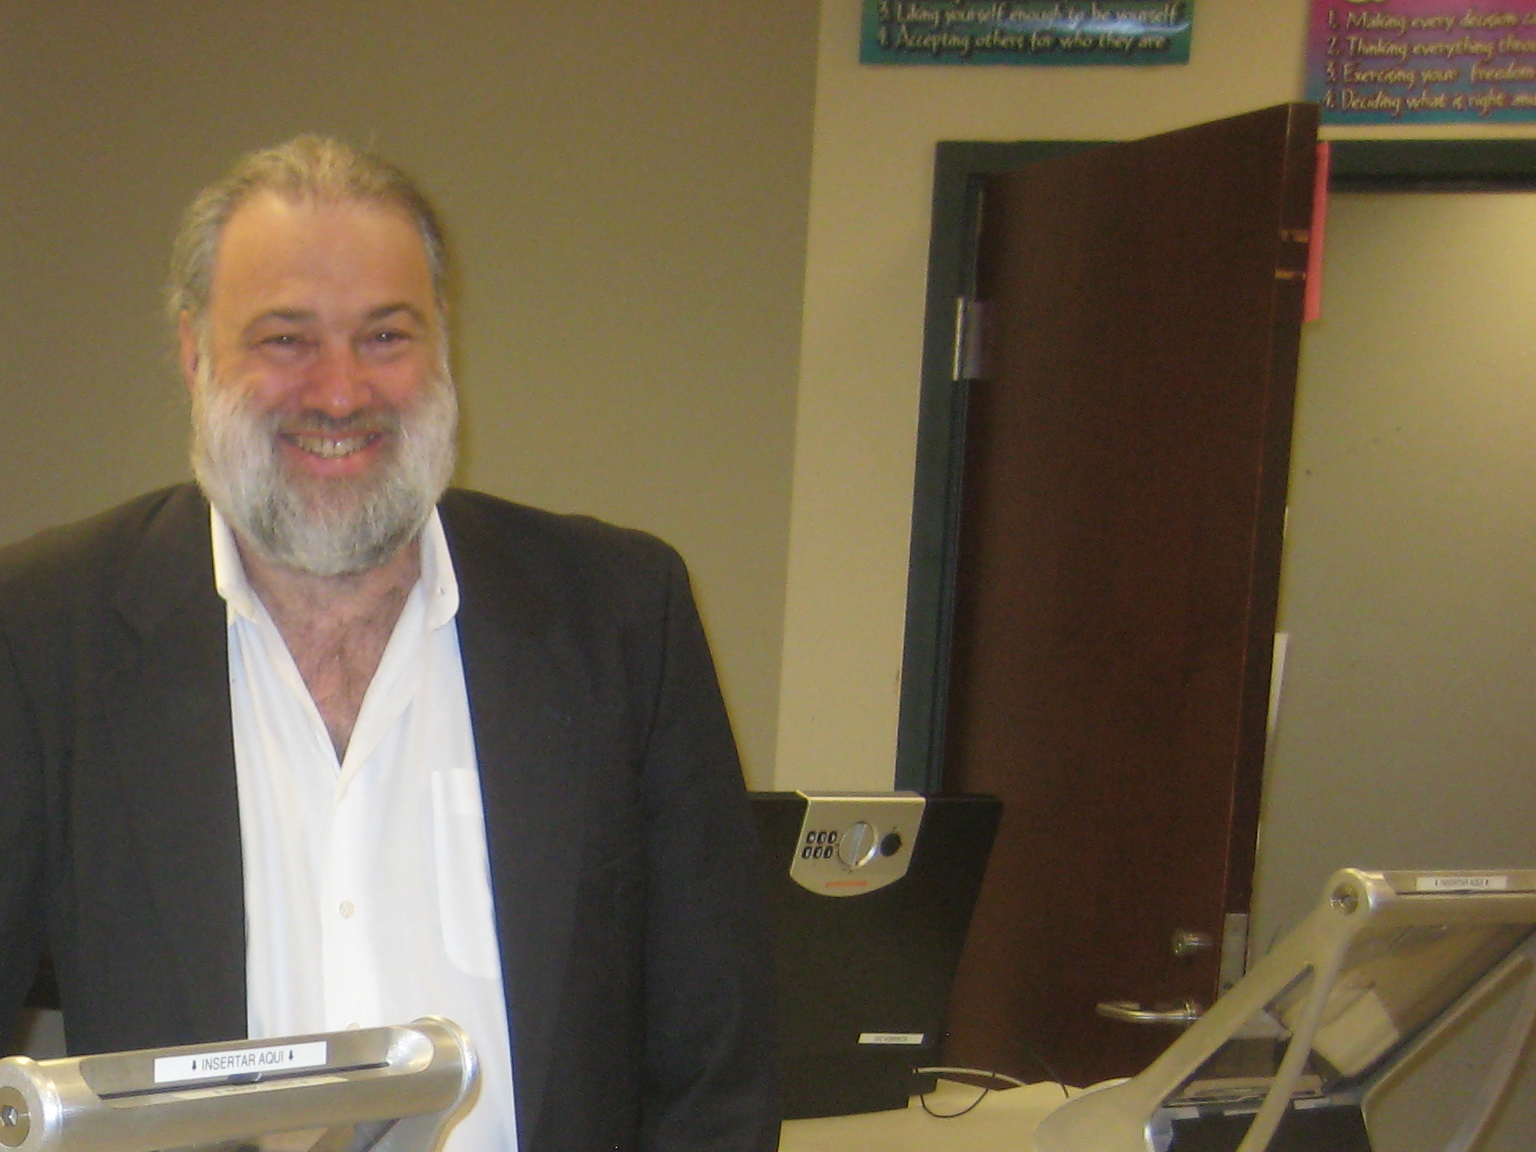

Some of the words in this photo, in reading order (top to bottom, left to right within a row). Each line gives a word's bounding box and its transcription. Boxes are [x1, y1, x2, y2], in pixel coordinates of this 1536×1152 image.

[897, 3, 940, 28] Liking
[944, 3, 1007, 27] yourself
[1090, 2, 1112, 20] be
[1328, 10, 1340, 29] 1.
[1346, 11, 1407, 37] Making
[1410, 16, 1456, 33] every
[1459, 8, 1517, 30] decision
[896, 24, 970, 54] Accepting
[975, 28, 1024, 49] others
[1031, 30, 1052, 52] for
[1060, 30, 1094, 49] who
[1098, 30, 1134, 53] they
[1138, 36, 1170, 50] are
[1327, 36, 1341, 56] 2.
[1346, 36, 1408, 62] Thinking
[1412, 36, 1495, 63] everything
[1326, 61, 1337, 82] 3.
[1343, 62, 1417, 91] Exercising
[1420, 69, 1460, 89] your
[1470, 60, 1535, 85] freedom
[1341, 88, 1401, 118] Deciding
[1406, 89, 1447, 110] what
[1452, 95, 1463, 110] is
[1468, 87, 1506, 117] right
[202, 1053, 256, 1071] INSERTAR
[258, 1051, 284, 1066] AQUI
